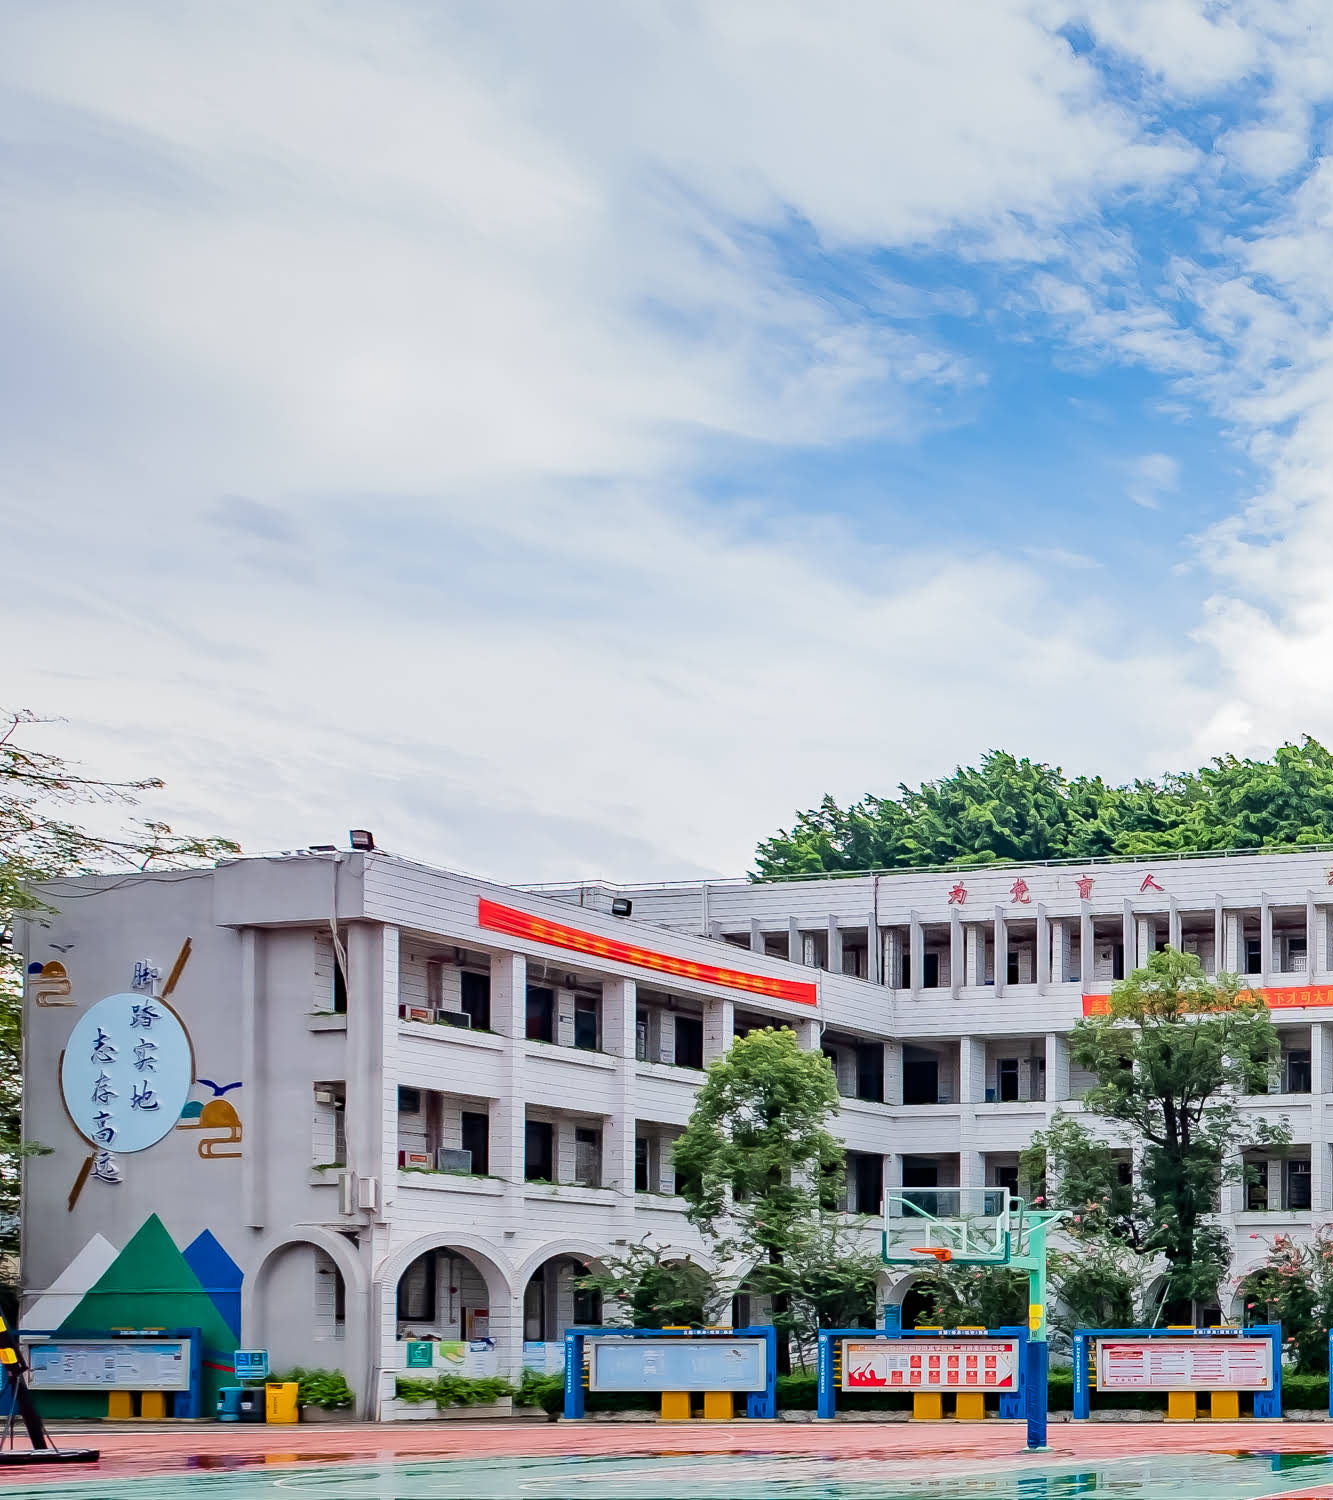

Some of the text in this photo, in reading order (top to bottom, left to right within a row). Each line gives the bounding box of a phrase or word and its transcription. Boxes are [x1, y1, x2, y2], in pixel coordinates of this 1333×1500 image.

[948, 874, 1165, 905] 为党育人
[90, 1027, 124, 1184] 志存高远
[129, 959, 162, 1112] 脚踏实地
